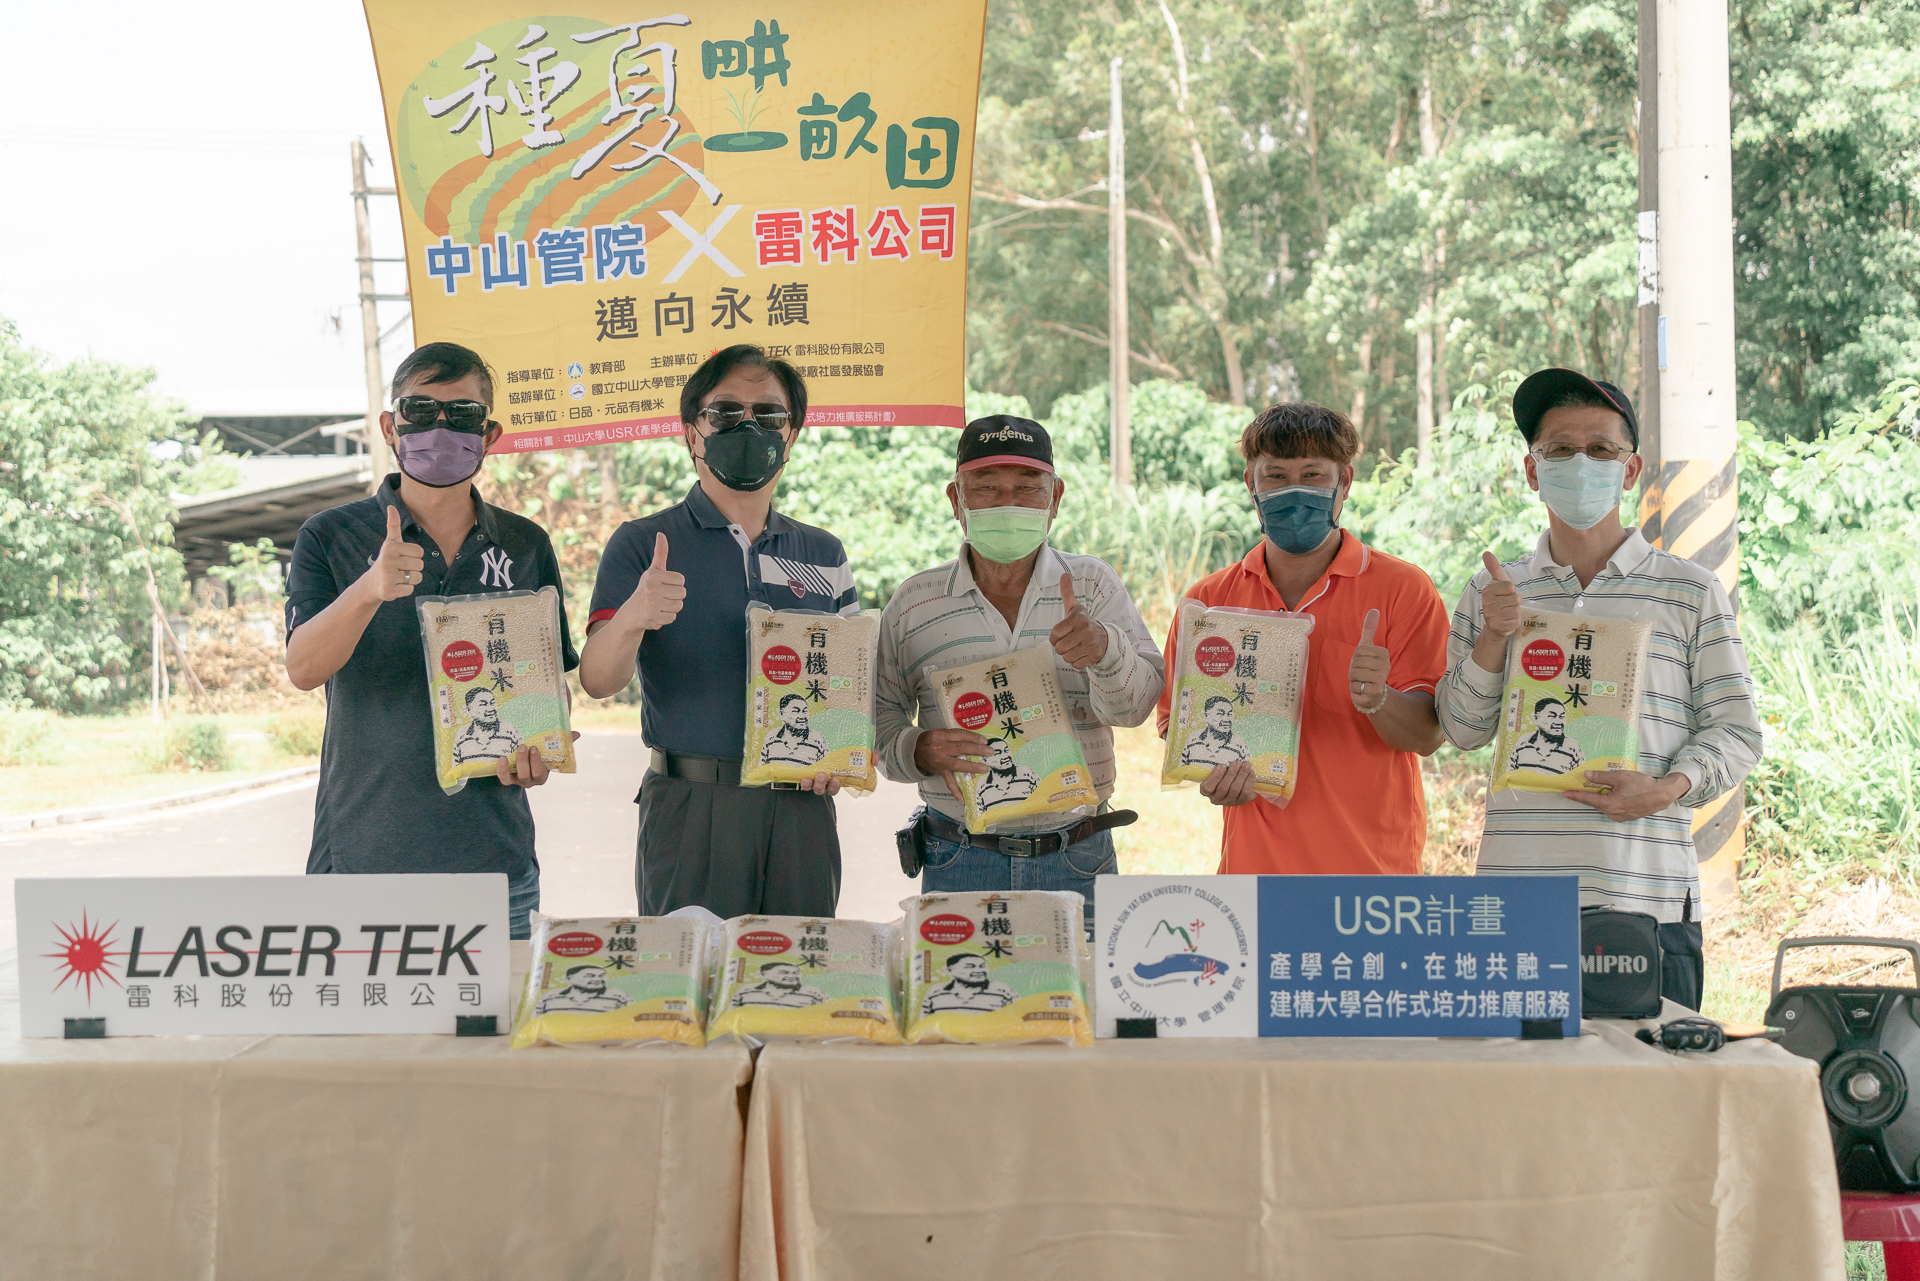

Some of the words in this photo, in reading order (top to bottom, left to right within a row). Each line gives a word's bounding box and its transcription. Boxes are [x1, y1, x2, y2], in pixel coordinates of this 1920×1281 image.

[426, 223, 648, 294] 中山管院
[754, 206, 956, 267] 雷科公司
[595, 282, 810, 342] 邁向永續
[589, 360, 626, 375] 教育部
[768, 345, 792, 357] TEK
[795, 343, 885, 356] 雷科股份有限公司
[591, 374, 694, 396] 國立中山大學管理
[979, 426, 1034, 443] syngenta
[483, 613, 513, 692] 有機米
[805, 627, 829, 703] 有機米
[1231, 629, 1261, 706] 有機米
[1563, 628, 1595, 708] 有機米
[985, 668, 1024, 739] 有機米
[981, 898, 1013, 958] 有機米
[1108, 924, 1122, 956] NATIONAL
[1118, 909, 1131, 924] SUN
[1128, 891, 1153, 911] YAT-SEN
[1152, 885, 1193, 897] UNIVERSITY
[1195, 888, 1223, 908] COLLEGE
[1220, 905, 1231, 914] OF
[1227, 913, 1248, 956] MANAGEMENT
[1334, 894, 1506, 936] USR計畫
[126, 924, 341, 978] LASER
[359, 924, 488, 976] TEK
[604, 921, 640, 970] 有機米
[798, 922, 830, 968] 有機米
[126, 983, 482, 1008] 雷科股份有限公司
[1198, 976, 1245, 1022] 管理學院
[1270, 990, 1570, 1019] 建構大學合作式培力推廣服務
